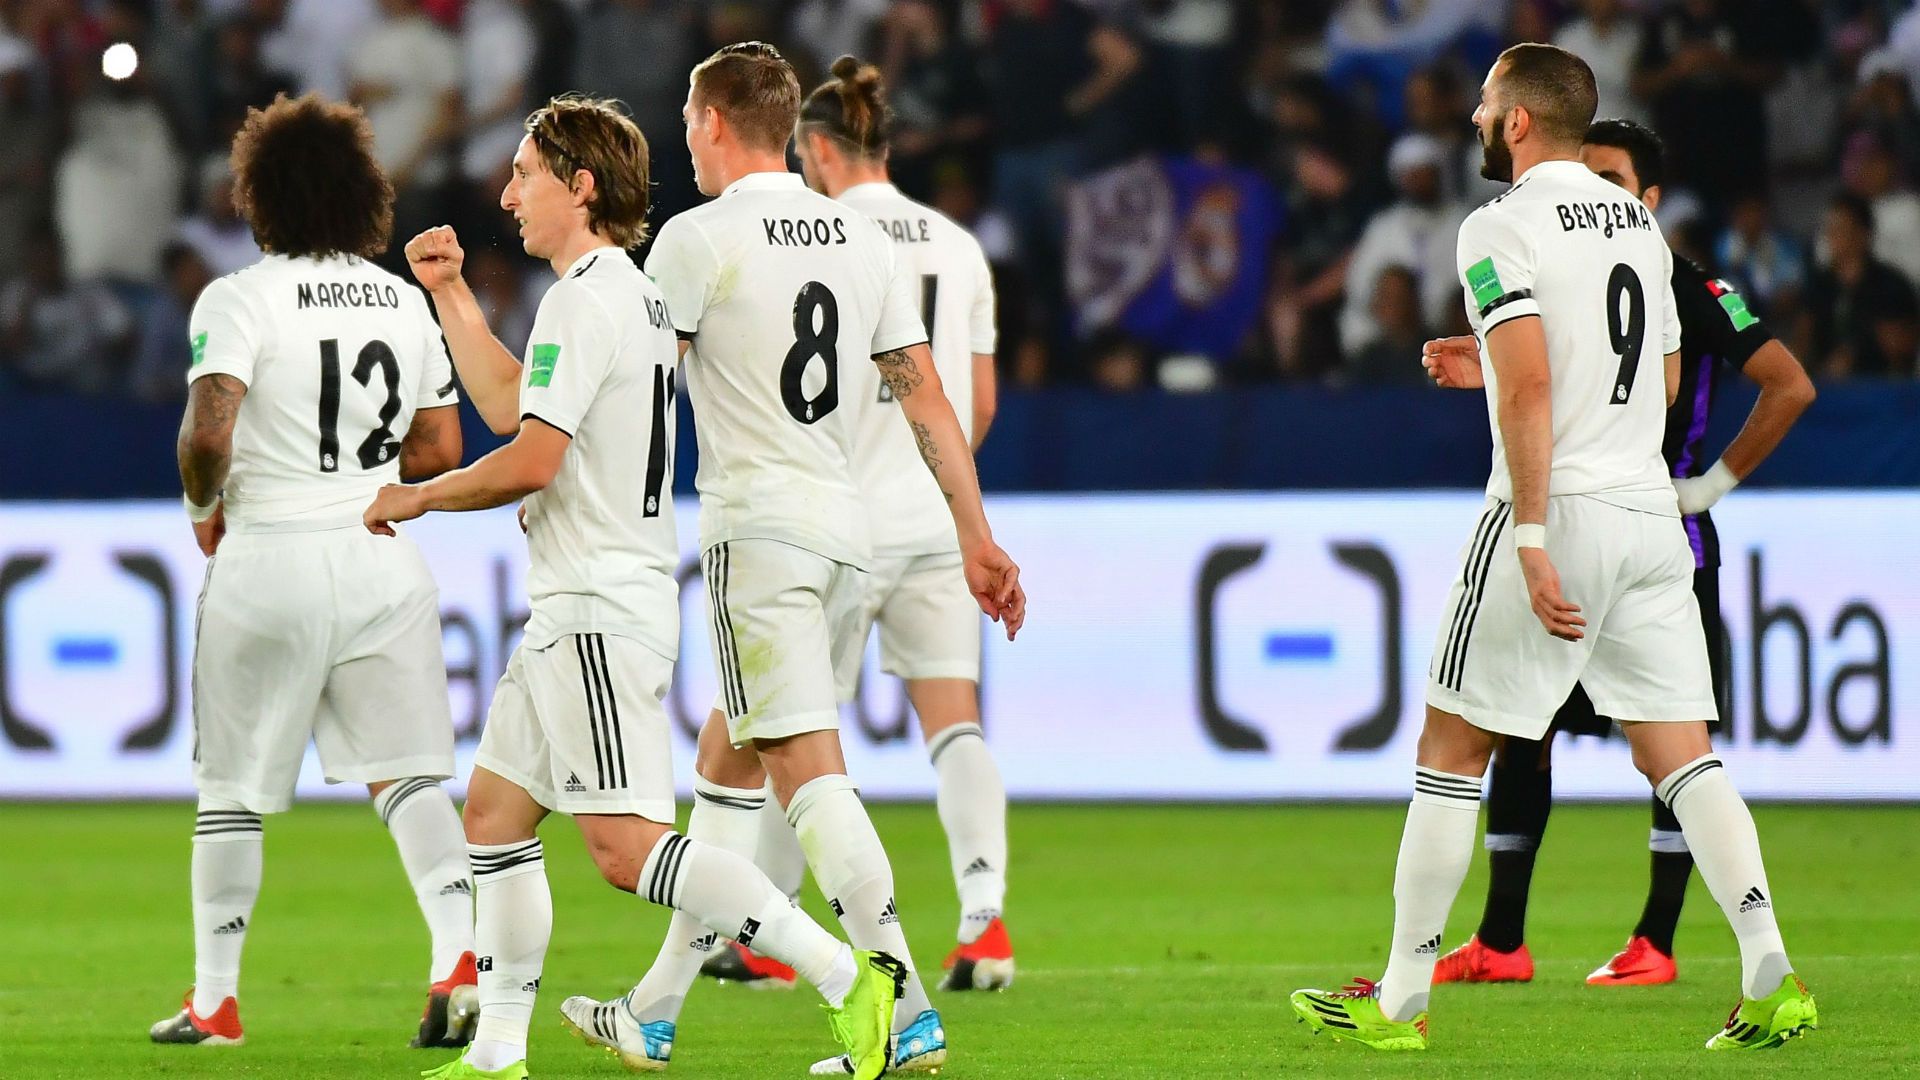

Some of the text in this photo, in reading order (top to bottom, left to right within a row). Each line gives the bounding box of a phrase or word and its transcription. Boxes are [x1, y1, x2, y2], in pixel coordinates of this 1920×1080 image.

[762, 217, 847, 247] KROOS
[1556, 202, 1651, 239] BENZEMA
[298, 282, 399, 309] MARCELO
[1606, 262, 1646, 405] 9
[780, 280, 839, 425] 8
[318, 338, 402, 473] 12
[1739, 899, 1771, 913] adidas
